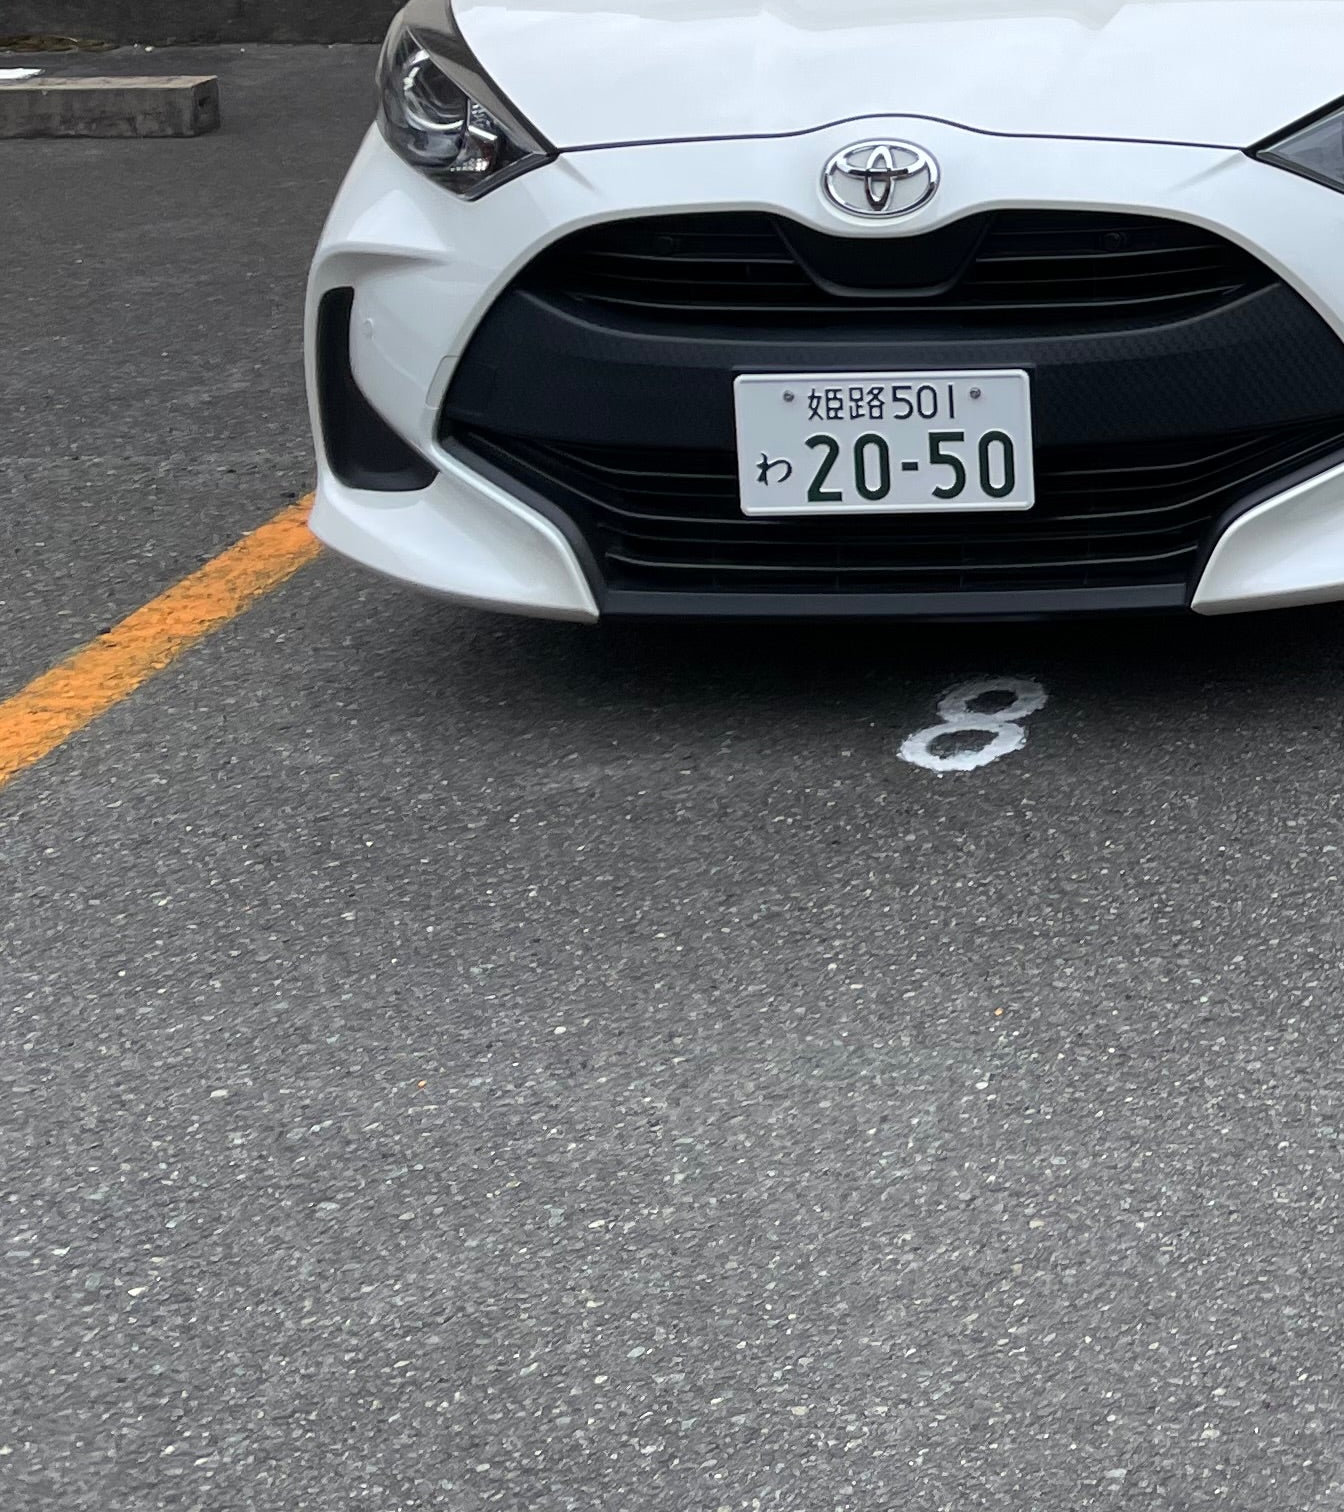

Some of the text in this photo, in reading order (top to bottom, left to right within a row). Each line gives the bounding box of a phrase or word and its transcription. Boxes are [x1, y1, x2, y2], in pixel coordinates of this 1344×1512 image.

[756, 430, 1015, 502] わ 20-50
[899, 676, 1048, 773] 8
